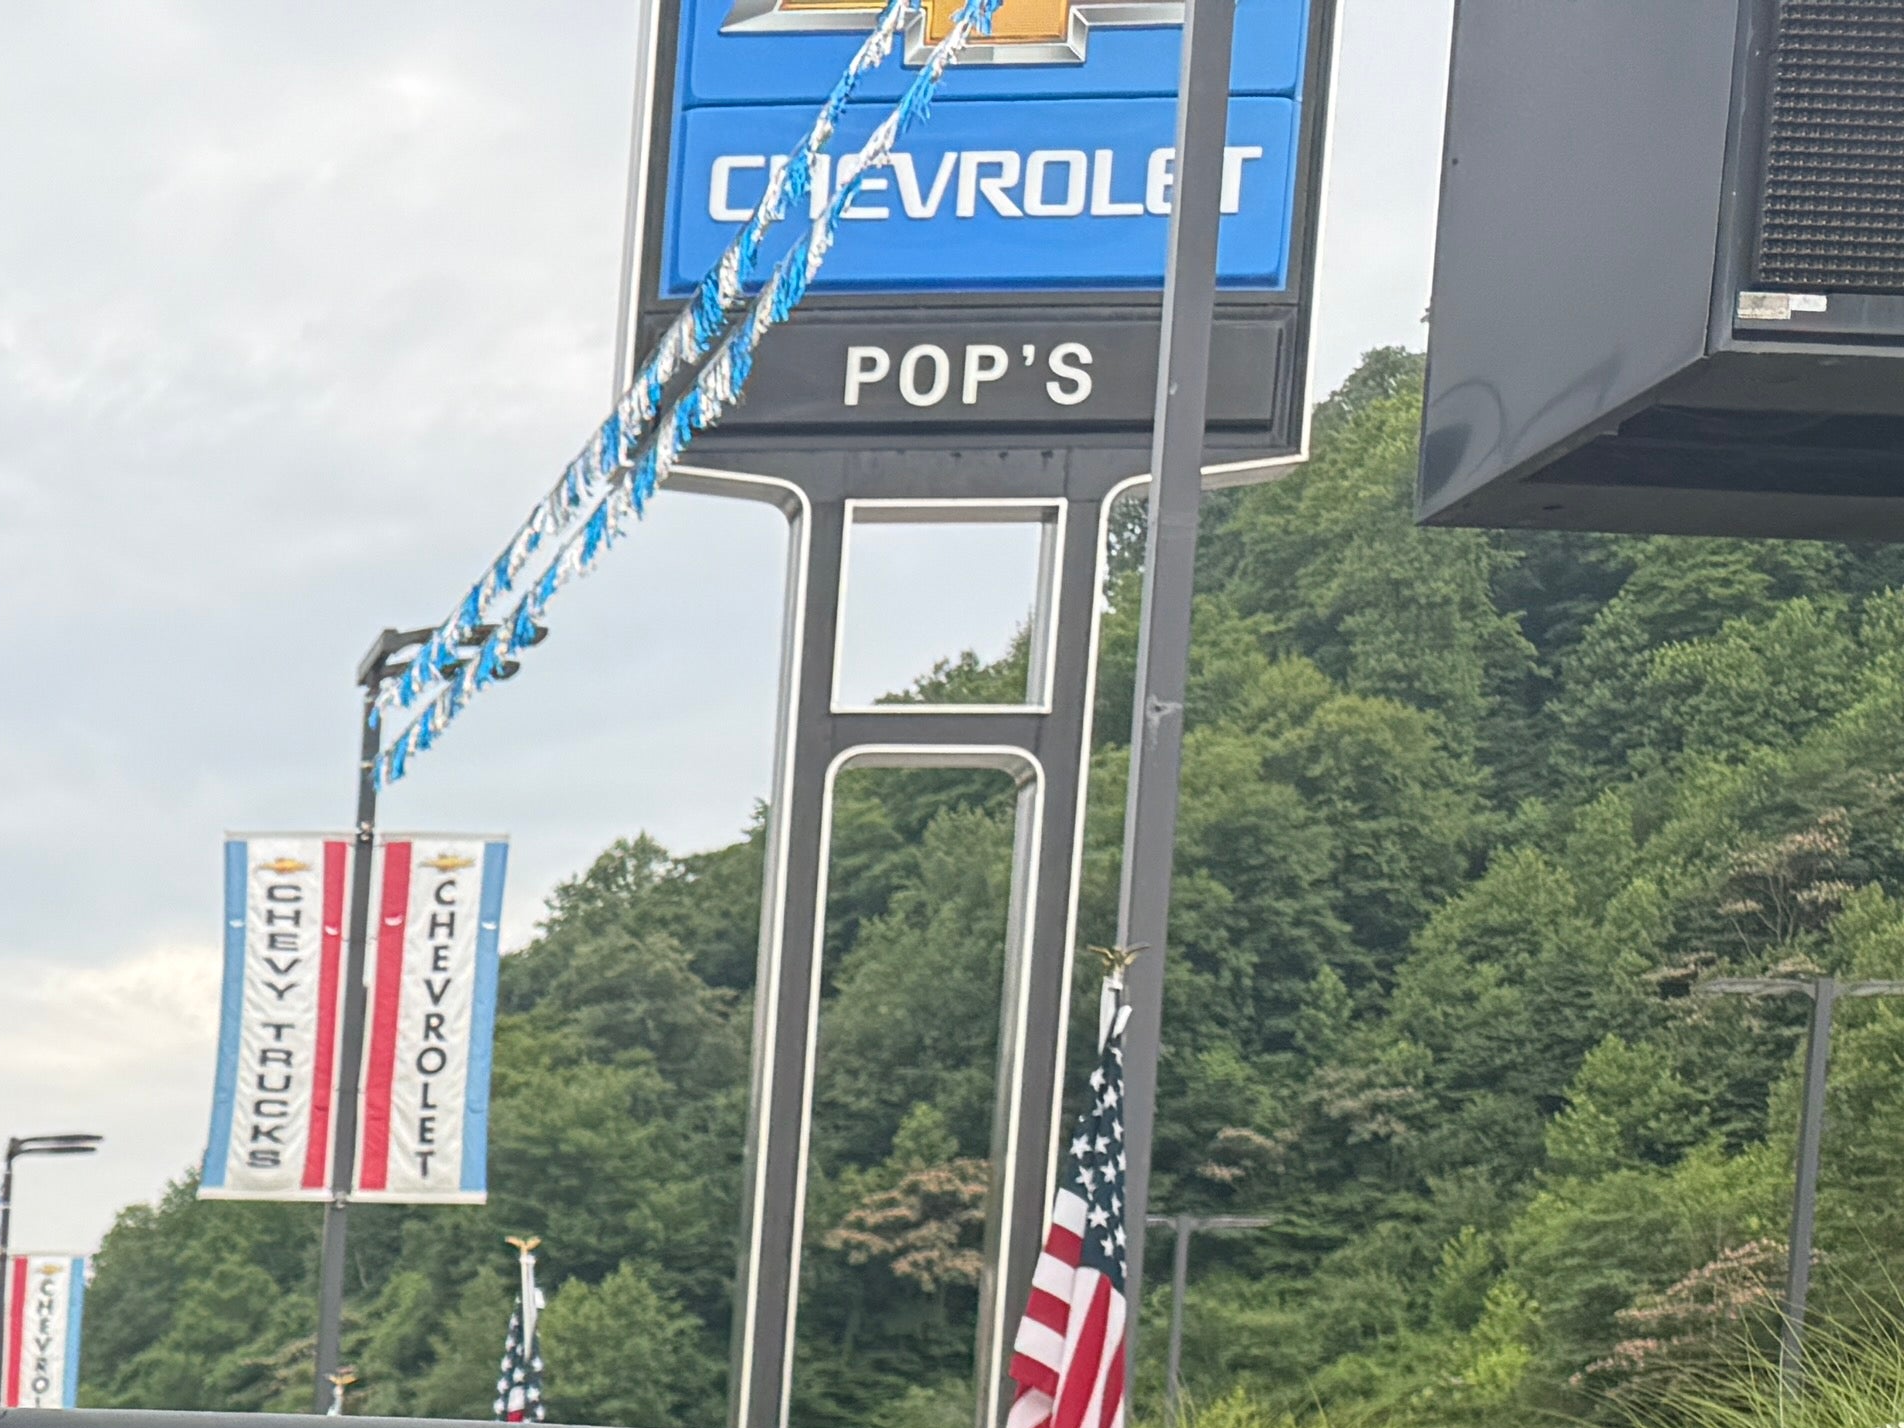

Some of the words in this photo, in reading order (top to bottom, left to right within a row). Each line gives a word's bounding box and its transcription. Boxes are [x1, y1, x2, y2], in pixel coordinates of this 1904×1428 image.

[709, 146, 1263, 222] CHEVROLET
[843, 342, 1094, 407] POP'S
[262, 884, 302, 1000] CHEVY
[415, 879, 456, 1179] CHEVROLET
[246, 1022, 296, 1169] TRUCKS
